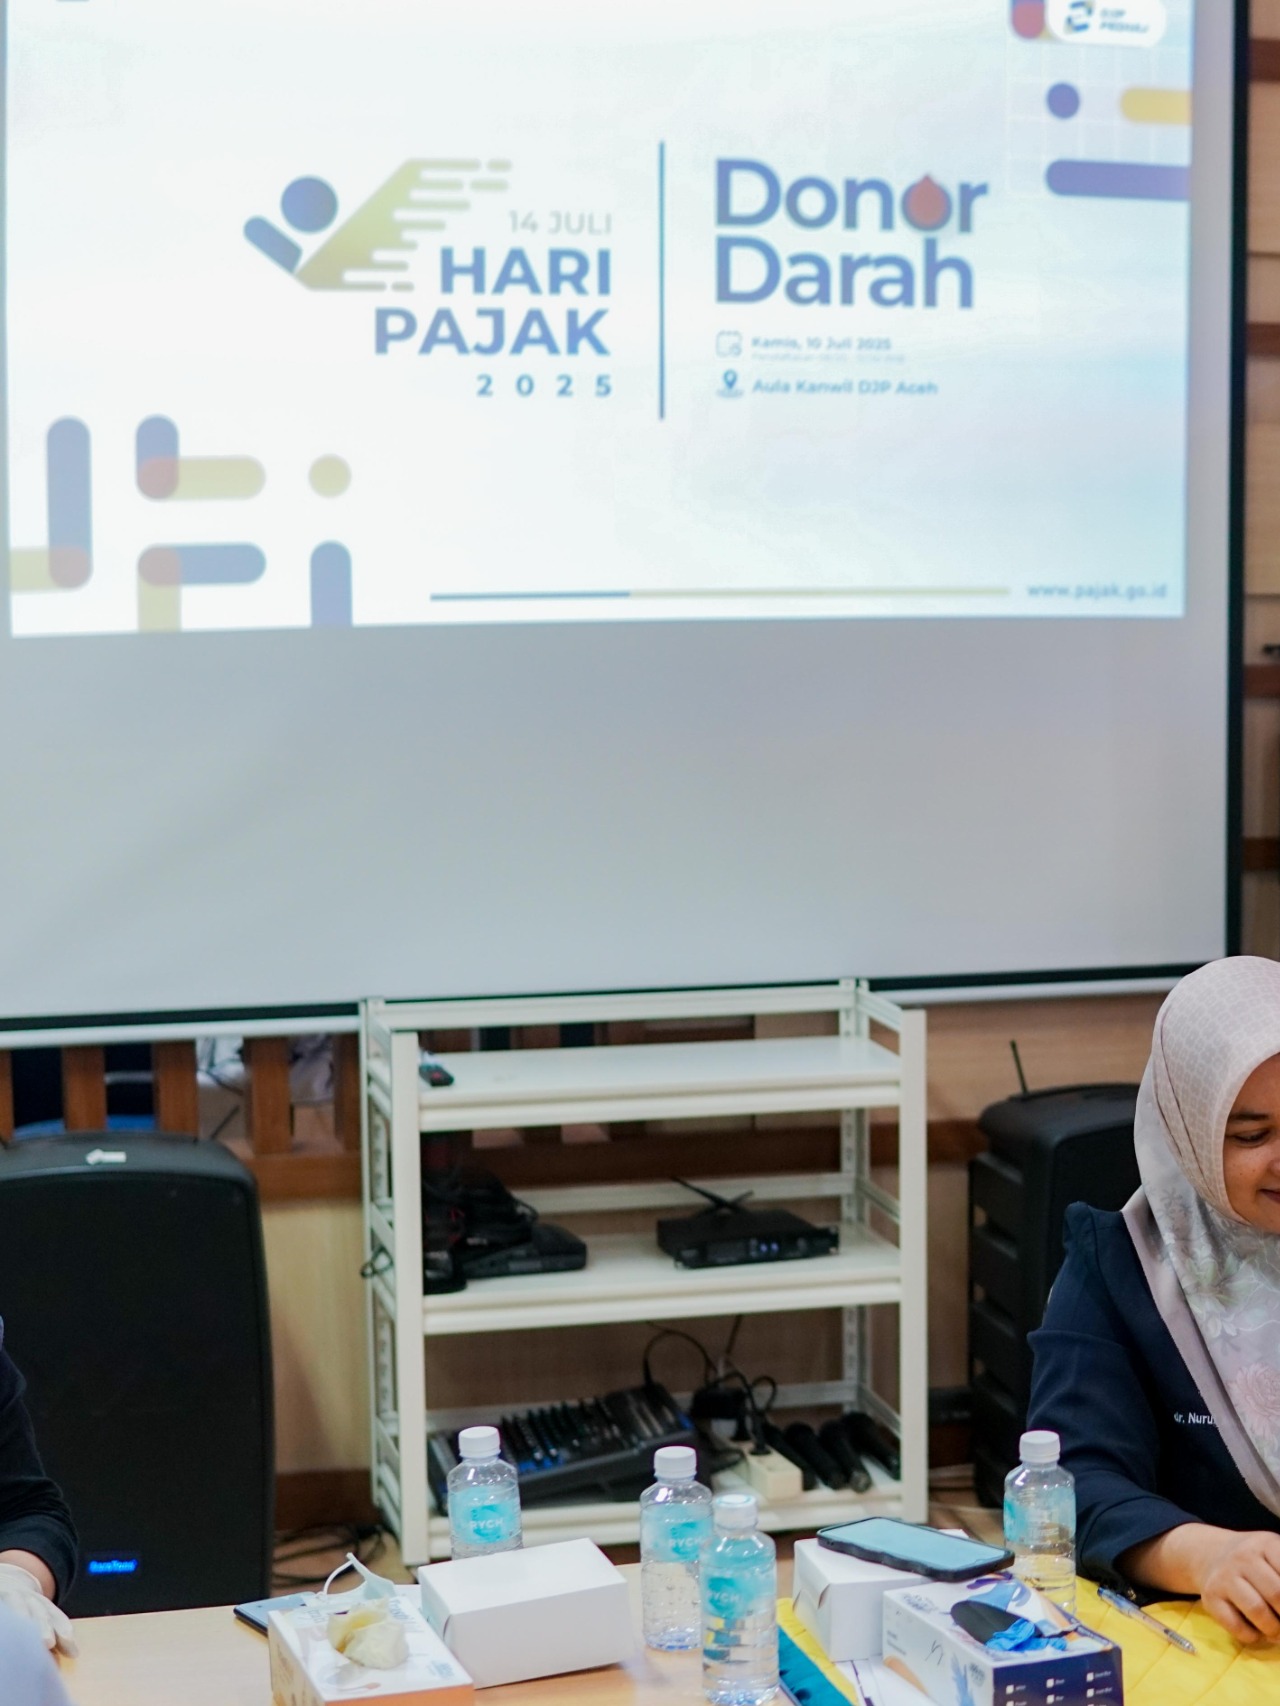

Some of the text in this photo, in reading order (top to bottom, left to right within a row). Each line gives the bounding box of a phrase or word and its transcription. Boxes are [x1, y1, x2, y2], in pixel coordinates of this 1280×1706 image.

[714, 157, 990, 233] Donor
[508, 210, 612, 236] 14 JULI
[440, 246, 611, 296] HARI
[714, 234, 974, 309] Darah
[374, 307, 611, 356] PAJAK
[857, 337, 892, 351] 2025
[476, 373, 612, 398] 2025
[752, 378, 791, 394] Aula
[796, 378, 853, 395] Kanwil
[896, 380, 939, 395] Aceh
[1027, 583, 1168, 601] www.pajak.go.id
[1188, 1412, 1215, 1425] Nuru
